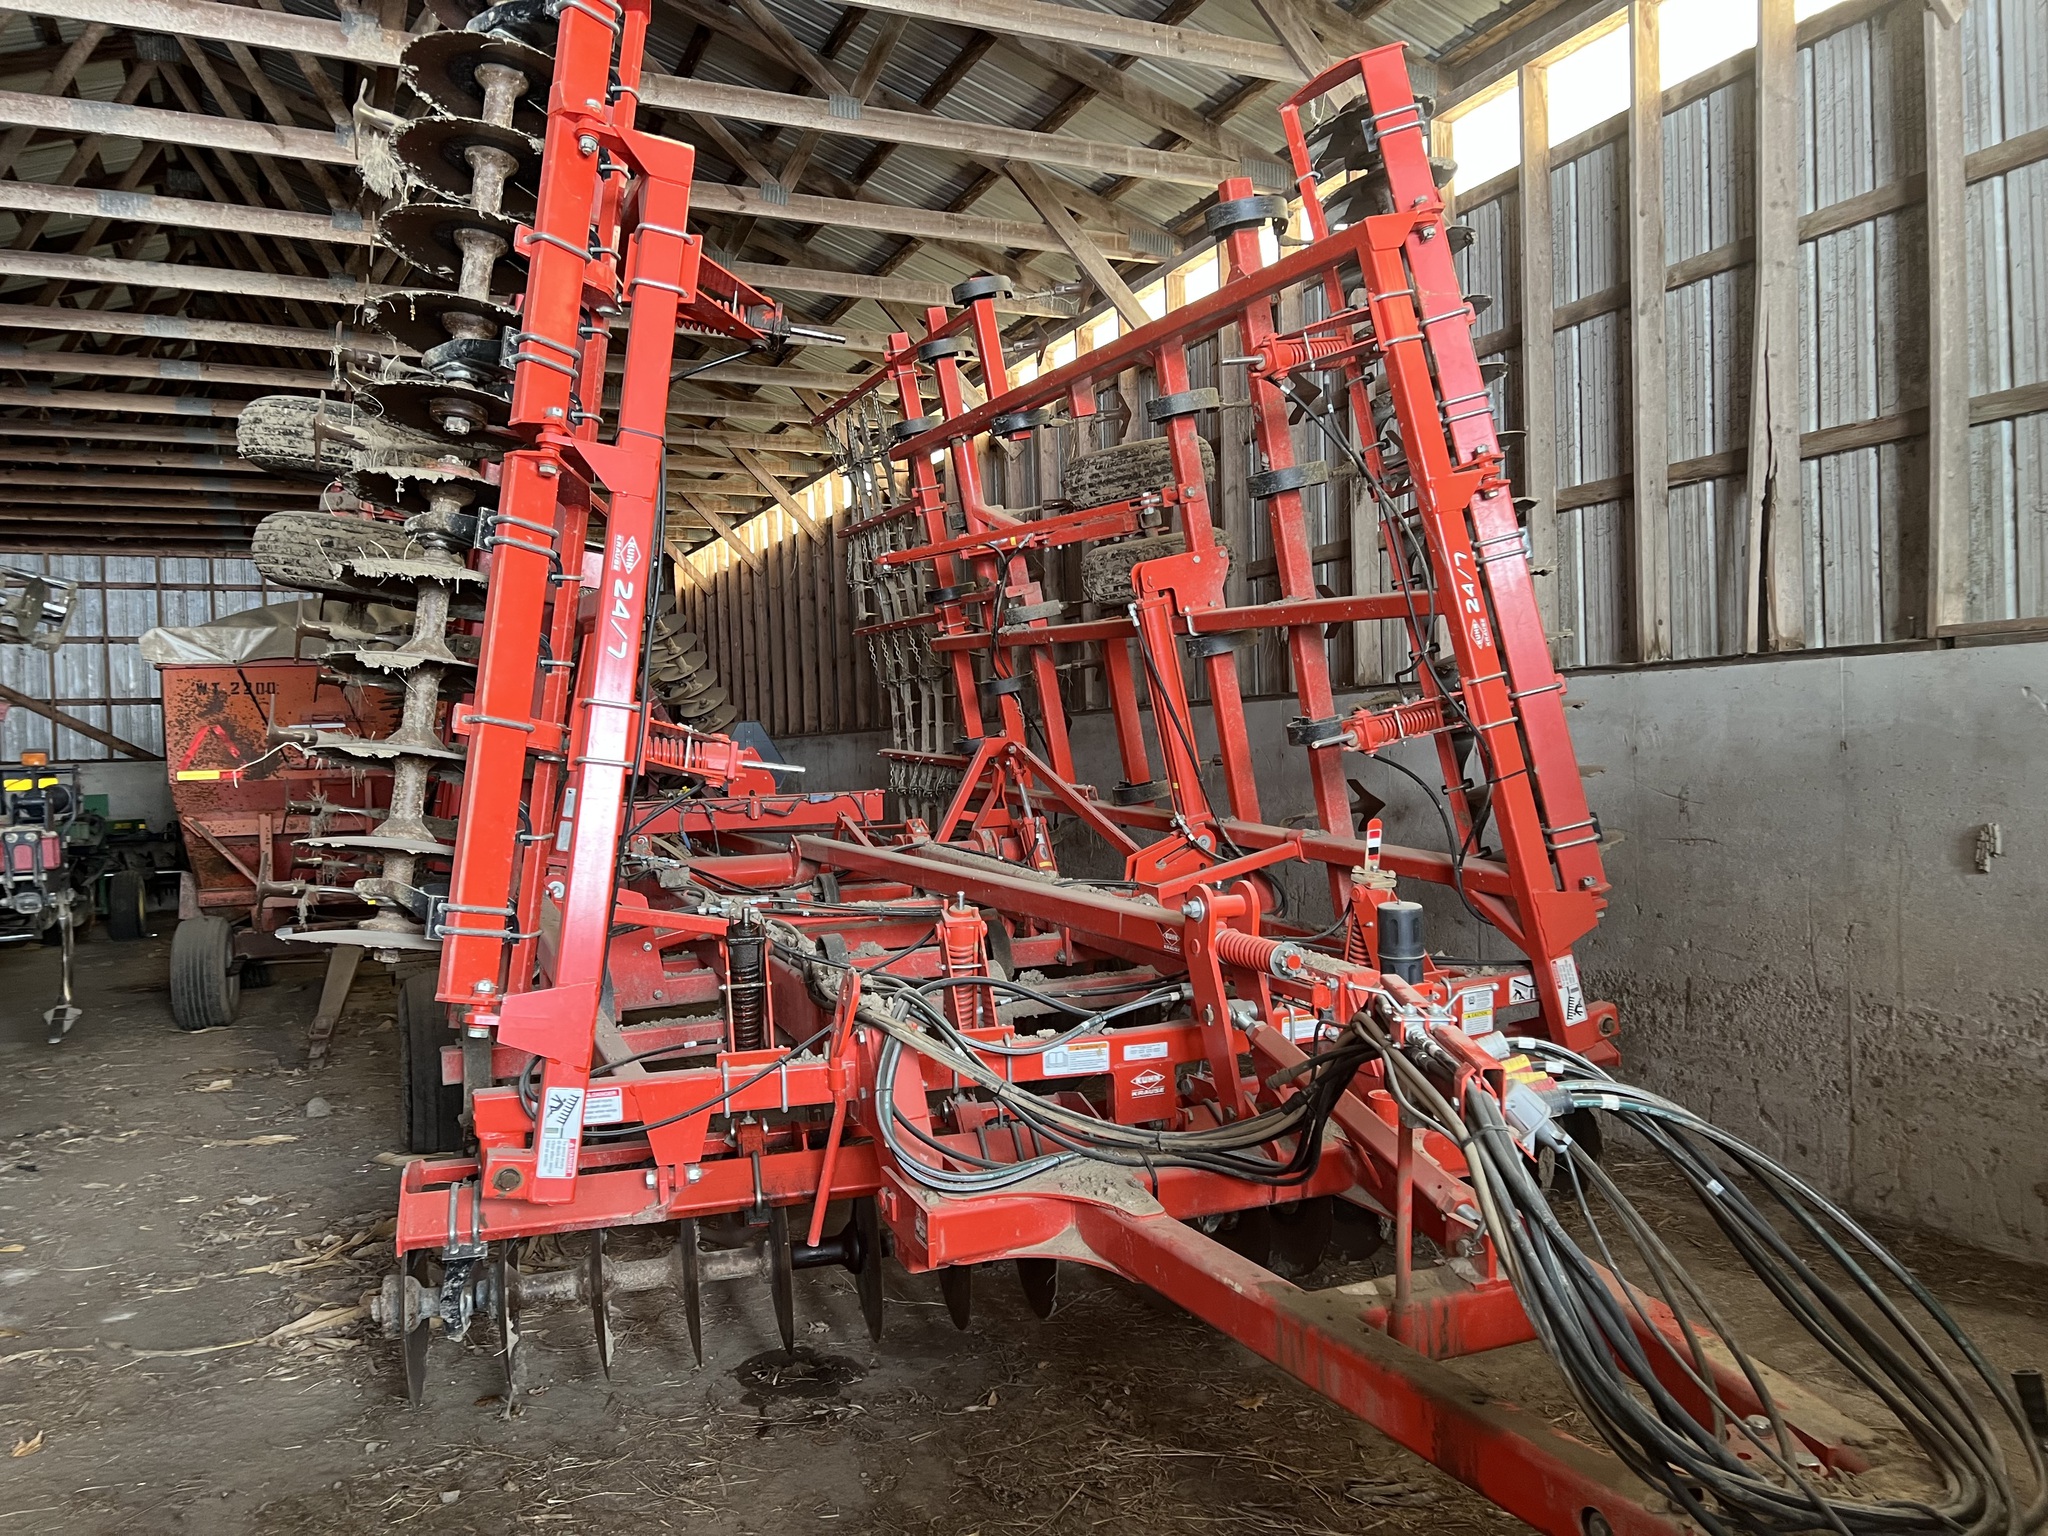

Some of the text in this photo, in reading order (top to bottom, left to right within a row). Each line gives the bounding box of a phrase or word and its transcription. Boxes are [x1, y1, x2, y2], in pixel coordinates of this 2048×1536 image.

[626, 539, 636, 570] KUHN
[1454, 551, 1480, 613] 24/7
[607, 578, 634, 659] 24/7
[1473, 621, 1483, 648] KUHN
[1131, 1087, 1165, 1097] KRAUSE
[1134, 1074, 1162, 1085] KUHN
